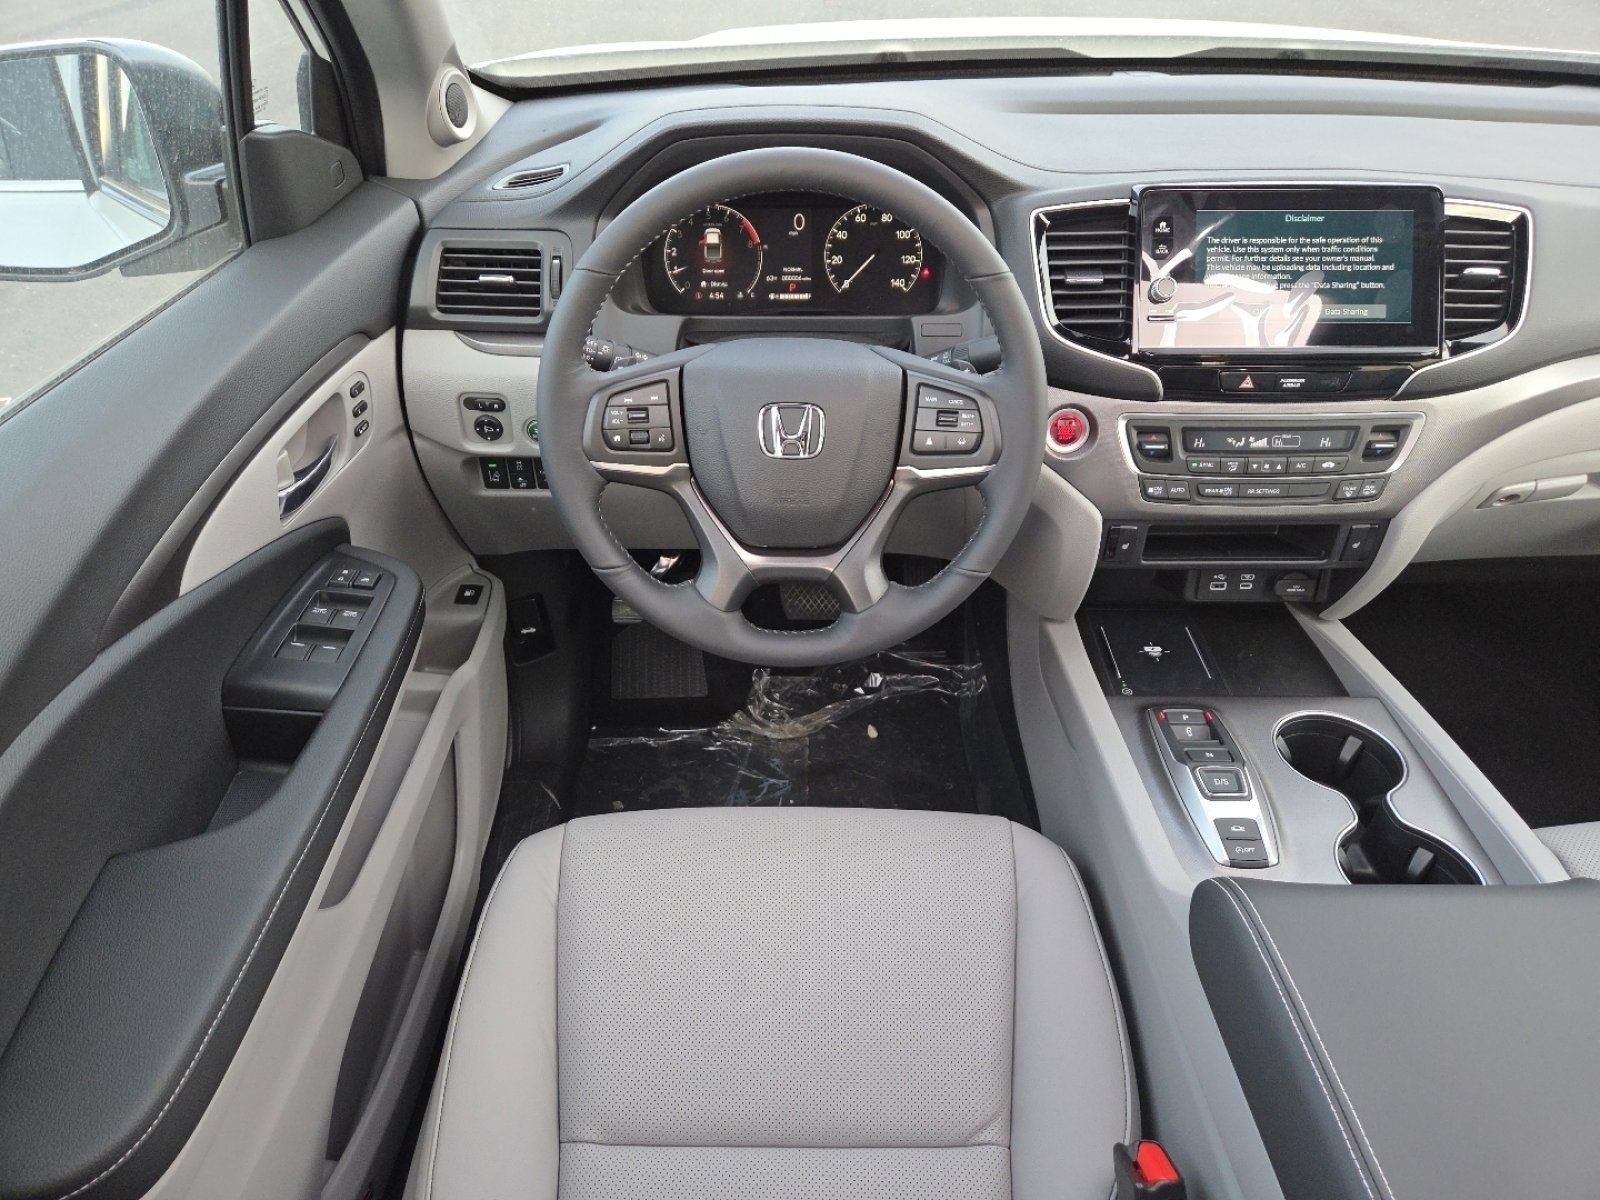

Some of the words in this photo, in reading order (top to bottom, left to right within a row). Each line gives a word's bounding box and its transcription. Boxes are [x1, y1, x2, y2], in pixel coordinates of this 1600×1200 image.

[855, 213, 867, 222] 60
[881, 213, 893, 222] 80
[1284, 214, 1325, 222] Disclaimer
[836, 230, 848, 239] 40
[895, 230, 911, 239] 100
[1207, 236, 1220, 244] The
[1221, 236, 1241, 244] driver
[1242, 236, 1248, 244] is
[1249, 236, 1287, 244] responsible
[1288, 236, 1298, 244] for
[1300, 236, 1310, 244] the
[1312, 236, 1326, 244] safe
[1328, 236, 1360, 244] operation
[1361, 236, 1369, 244] of
[1370, 236, 1383, 244] this
[671, 248, 677, 256] 2
[1206, 245, 1231, 253] vehicle.
[1233, 245, 1246, 253] Use
[1247, 245, 1259, 253] this
[1260, 245, 1284, 253] system
[1285, 245, 1300, 253] only
[1301, 245, 1320, 253] when
[1321, 245, 1341, 253] traffic
[1342, 245, 1378, 253] conditions
[831, 255, 843, 264] 20
[901, 255, 916, 264] 120
[1206, 254, 1230, 262] permit.
[1232, 254, 1243, 262] For
[1244, 254, 1269, 262] further
[1269, 254, 1290, 262] details
[1292, 254, 1304, 262] see
[1305, 254, 1320, 262] your
[1321, 254, 1348, 262] owner's
[1349, 254, 1375, 262] manual.
[1206, 263, 1220, 271] This
[1222, 263, 1245, 271] vehicle
[1246, 263, 1260, 271] may
[1261, 263, 1270, 271] be
[1271, 263, 1304, 271] uploading
[1305, 263, 1320, 271] data
[1321, 263, 1351, 271] including
[1352, 263, 1380, 271] location
[1381, 263, 1394, 271] and
[890, 278, 905, 287] 140
[789, 283, 797, 292] P
[1342, 308, 1368, 316] Sharing
